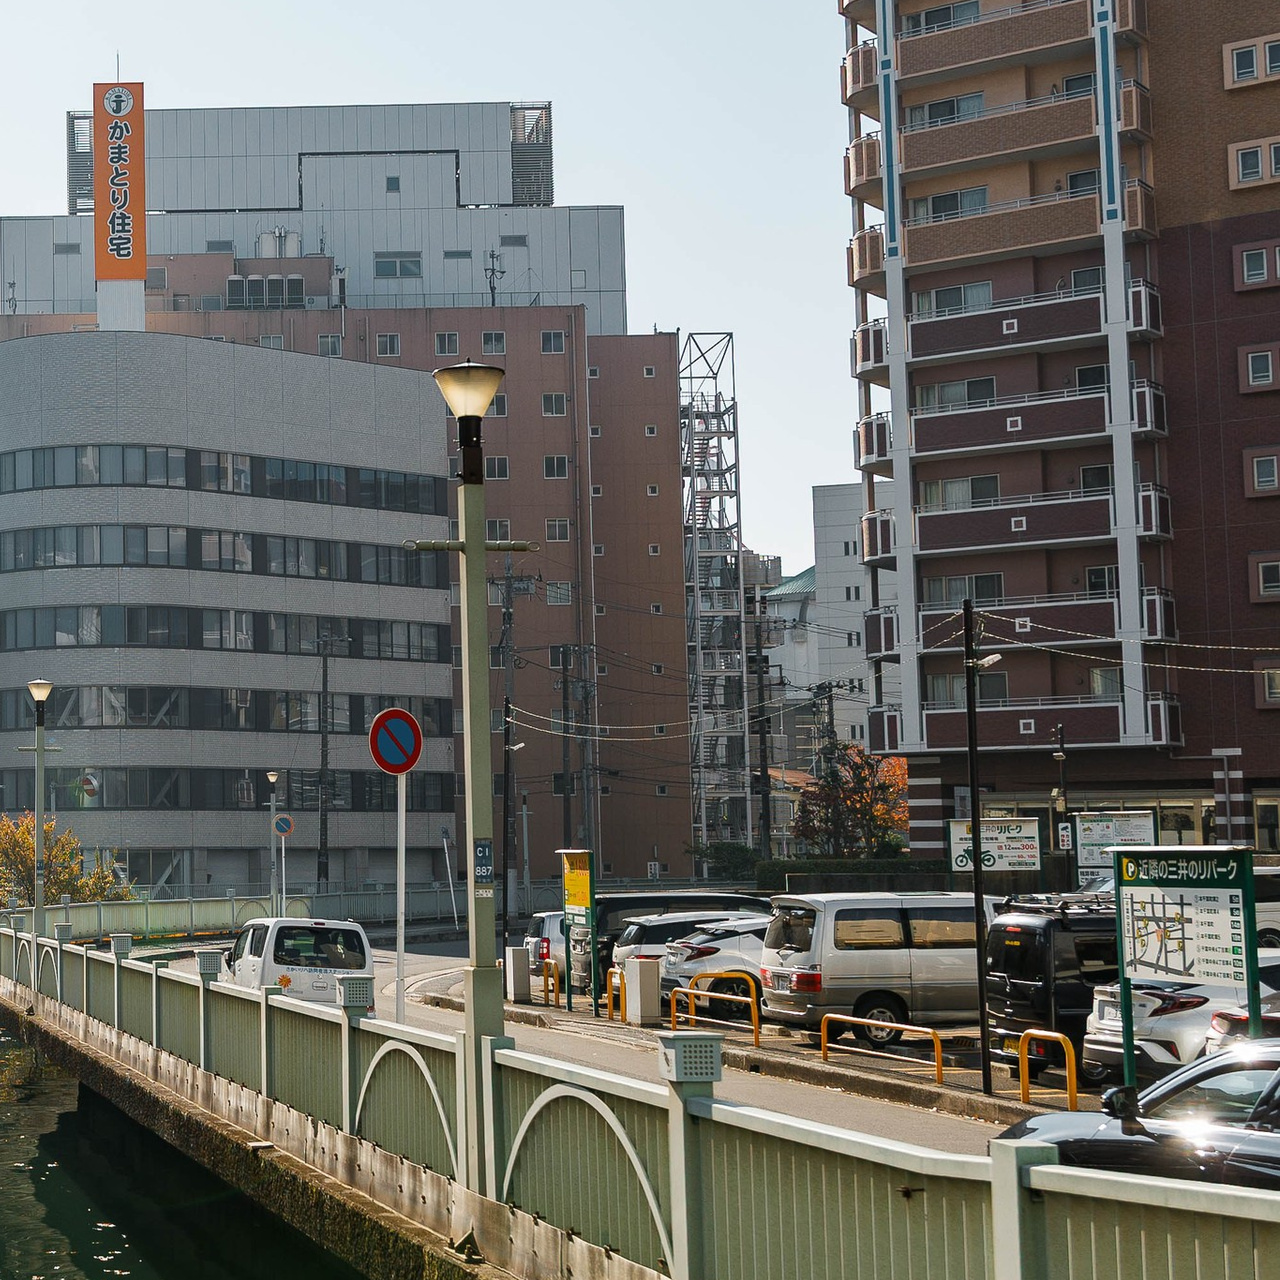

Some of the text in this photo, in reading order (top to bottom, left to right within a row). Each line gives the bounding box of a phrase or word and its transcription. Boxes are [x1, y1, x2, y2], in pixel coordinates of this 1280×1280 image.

[108, 121, 132, 258] かまとり住宅
[476, 866, 492, 876] 887
[1138, 860, 1238, 880] 近隣の三井のリパーク
